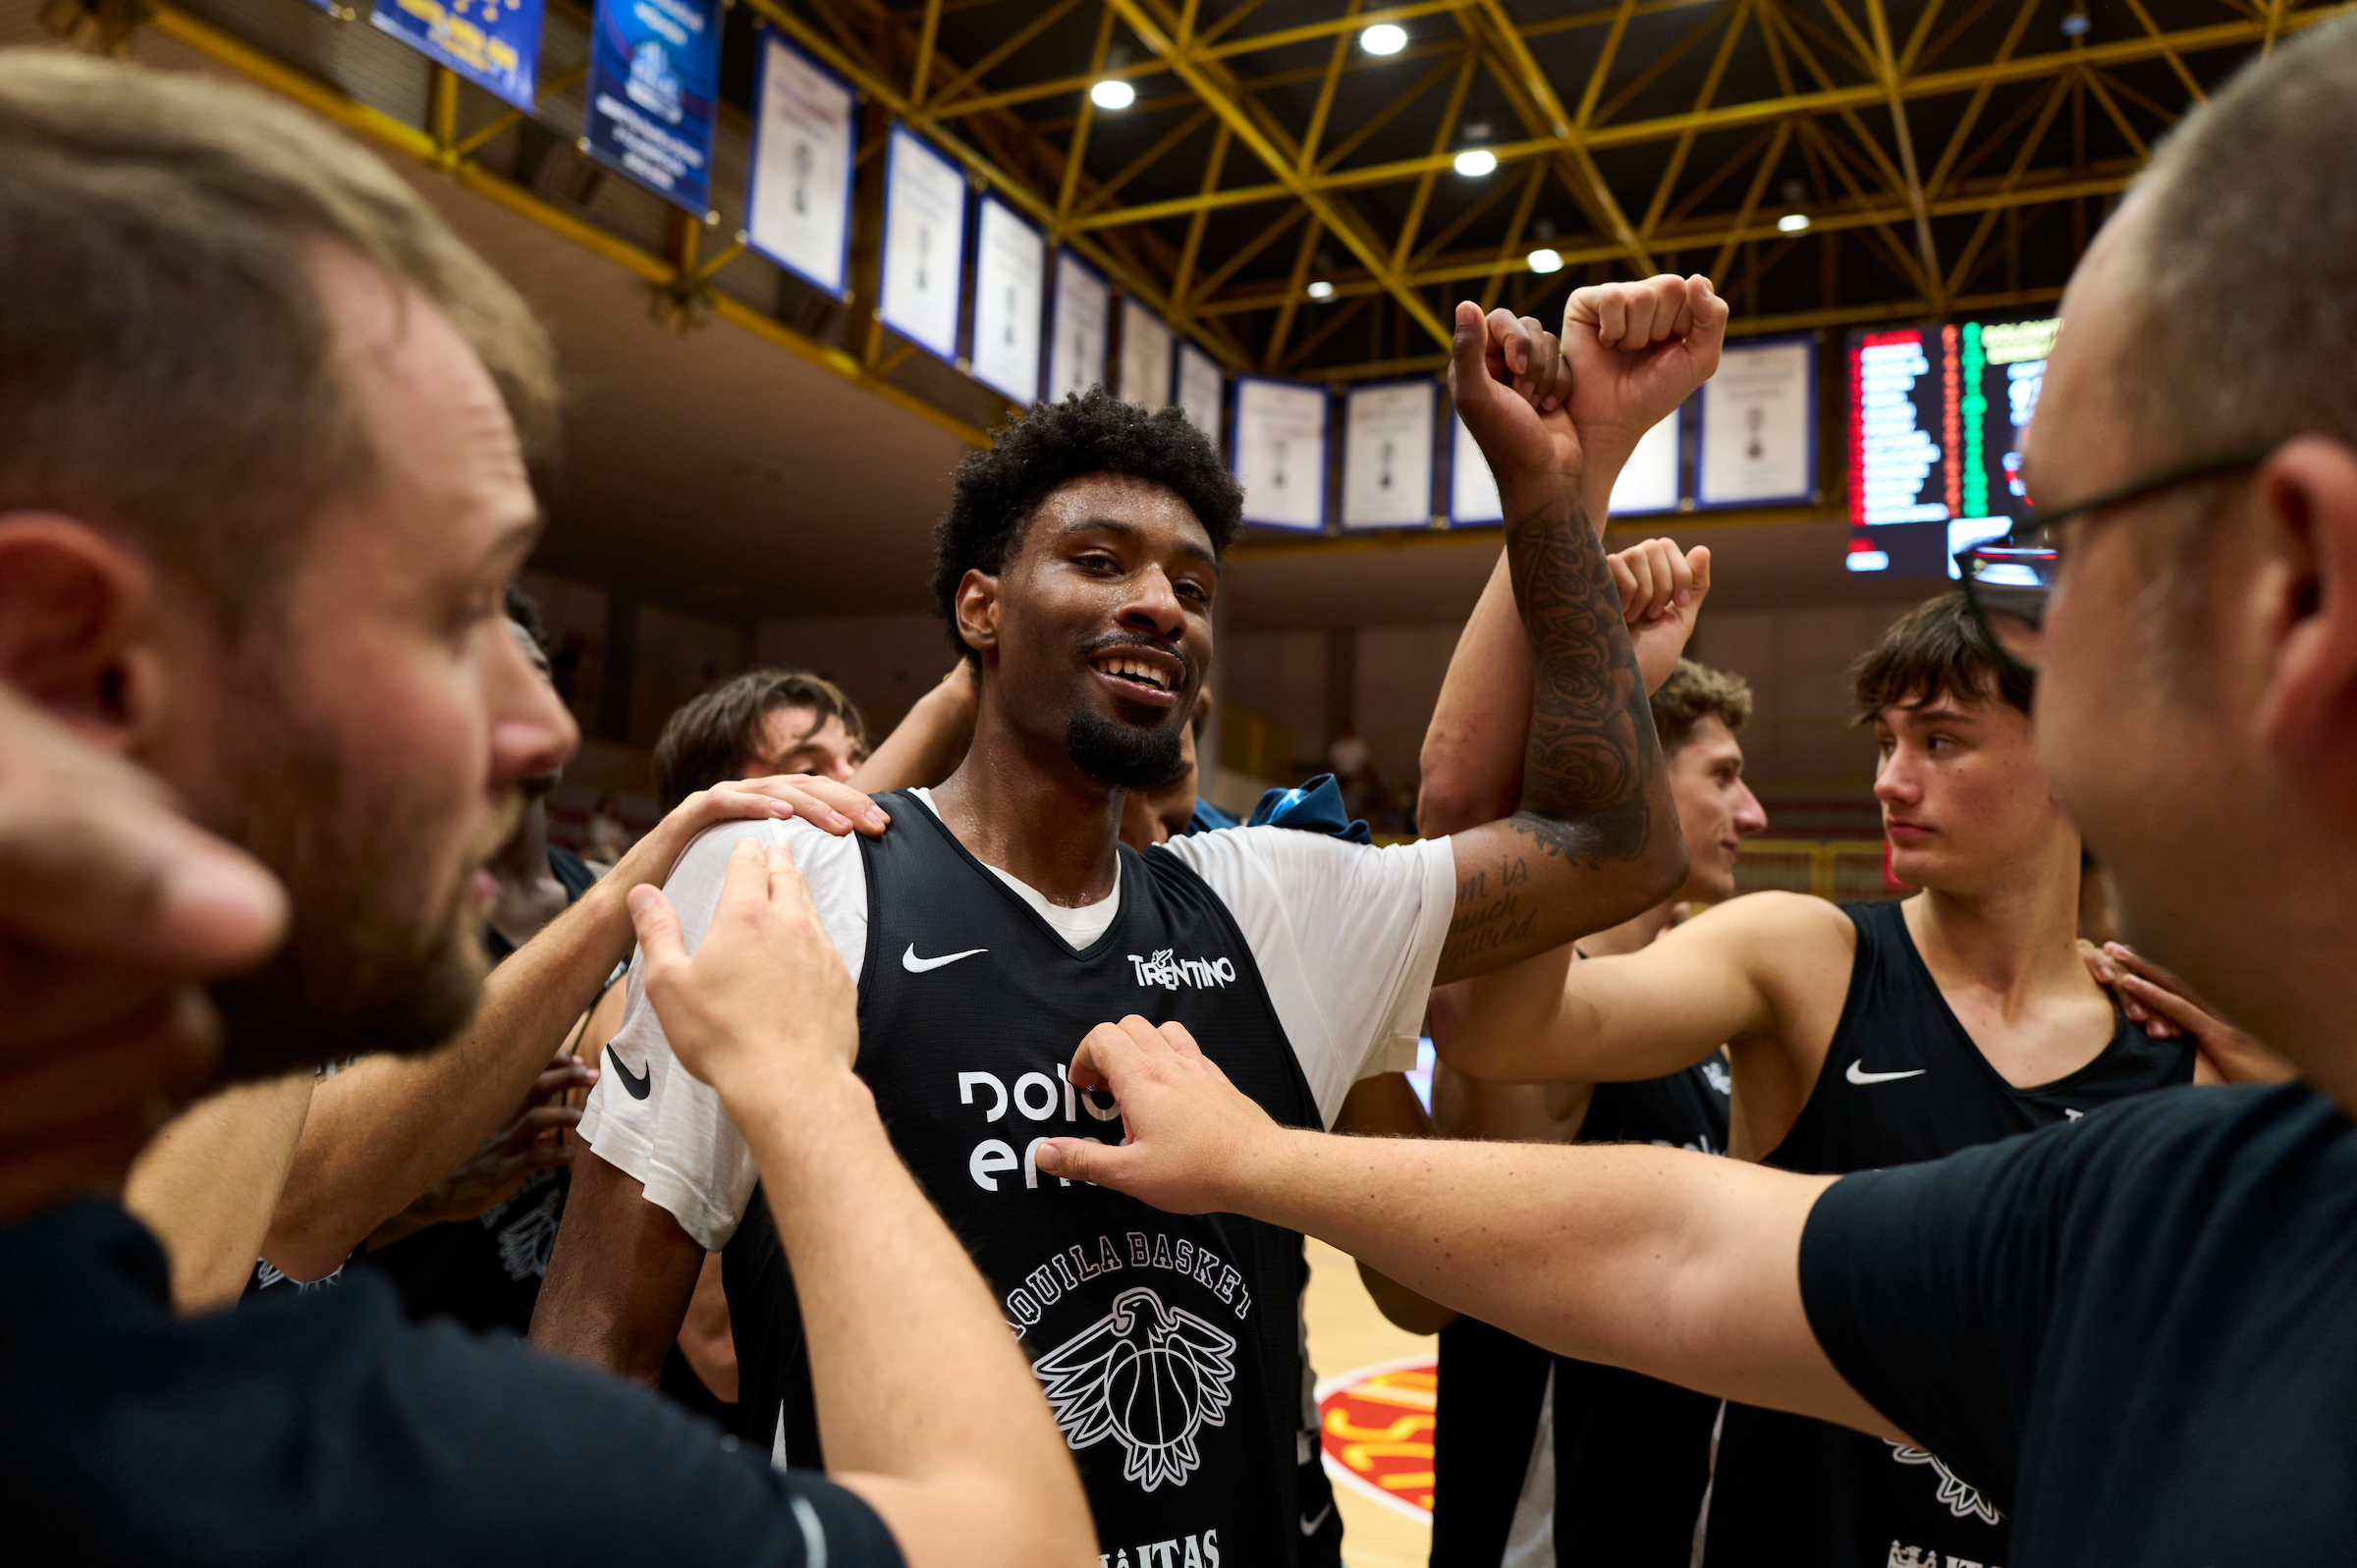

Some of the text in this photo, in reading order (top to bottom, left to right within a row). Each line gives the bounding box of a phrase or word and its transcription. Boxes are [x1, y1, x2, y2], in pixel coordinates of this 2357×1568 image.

[1503, 854, 1530, 887] is
[1127, 952, 1236, 991] TRENTINO
[1005, 1235, 1123, 1339] QUILA
